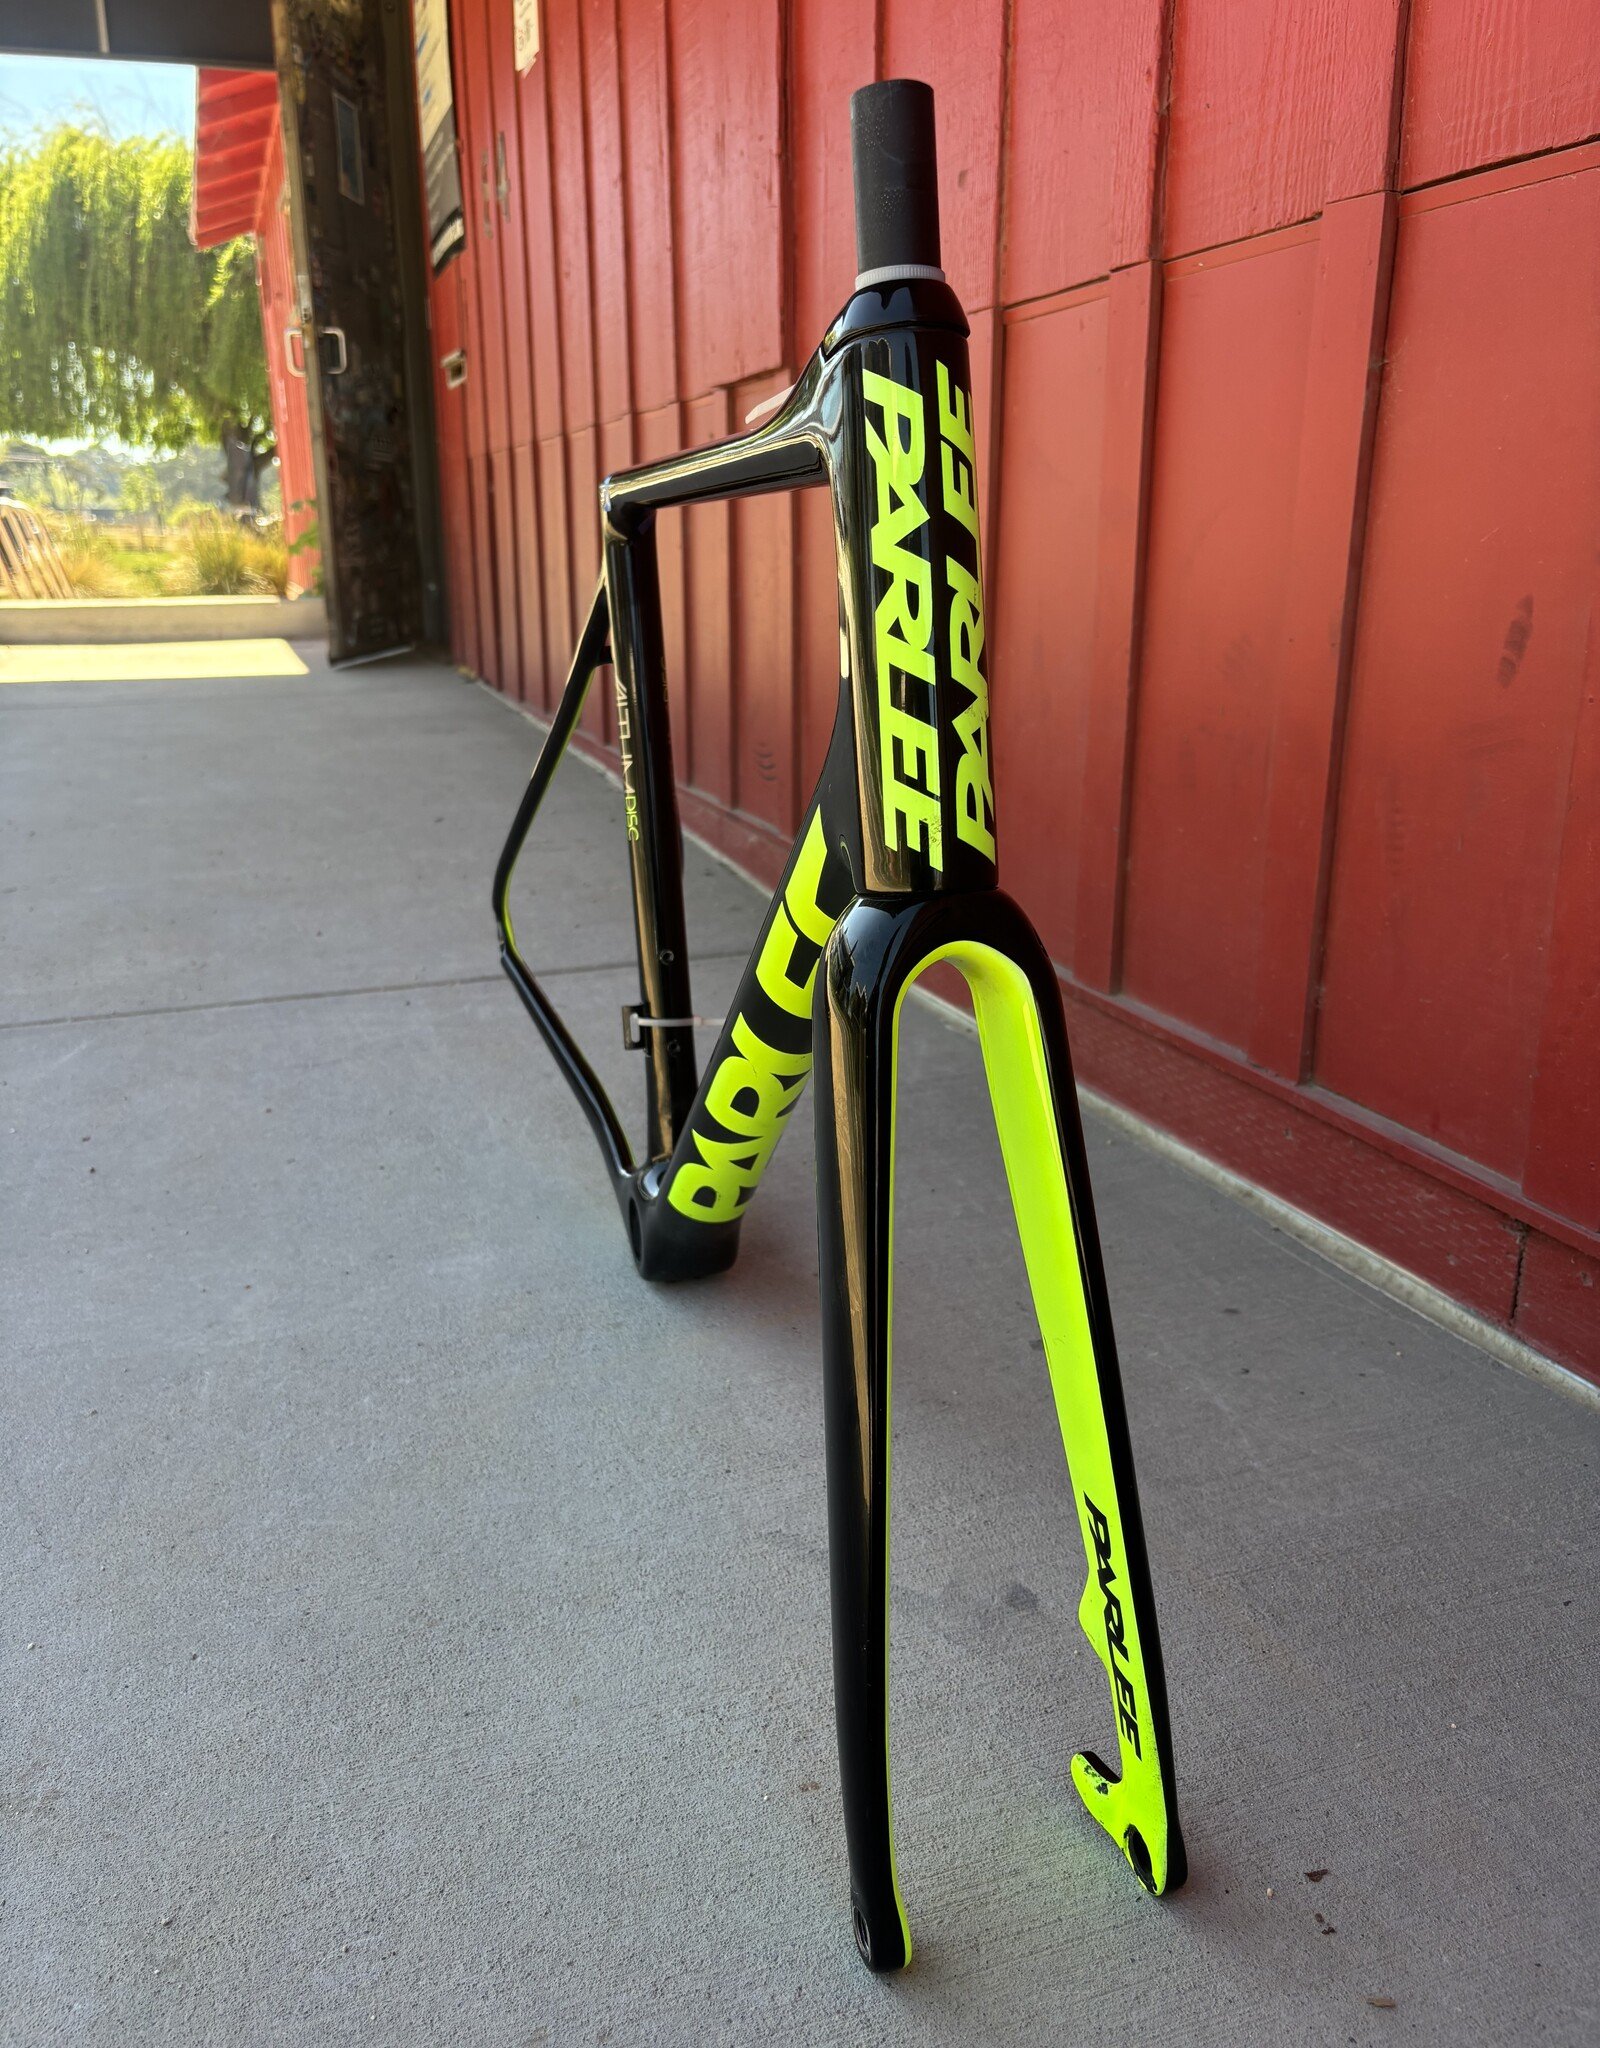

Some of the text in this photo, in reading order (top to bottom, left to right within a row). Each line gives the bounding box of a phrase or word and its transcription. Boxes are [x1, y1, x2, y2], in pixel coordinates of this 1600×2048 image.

[863, 368, 943, 873] PARLEE
[936, 360, 996, 866] PARLEE
[1084, 1490, 1142, 1761] PARLEE
